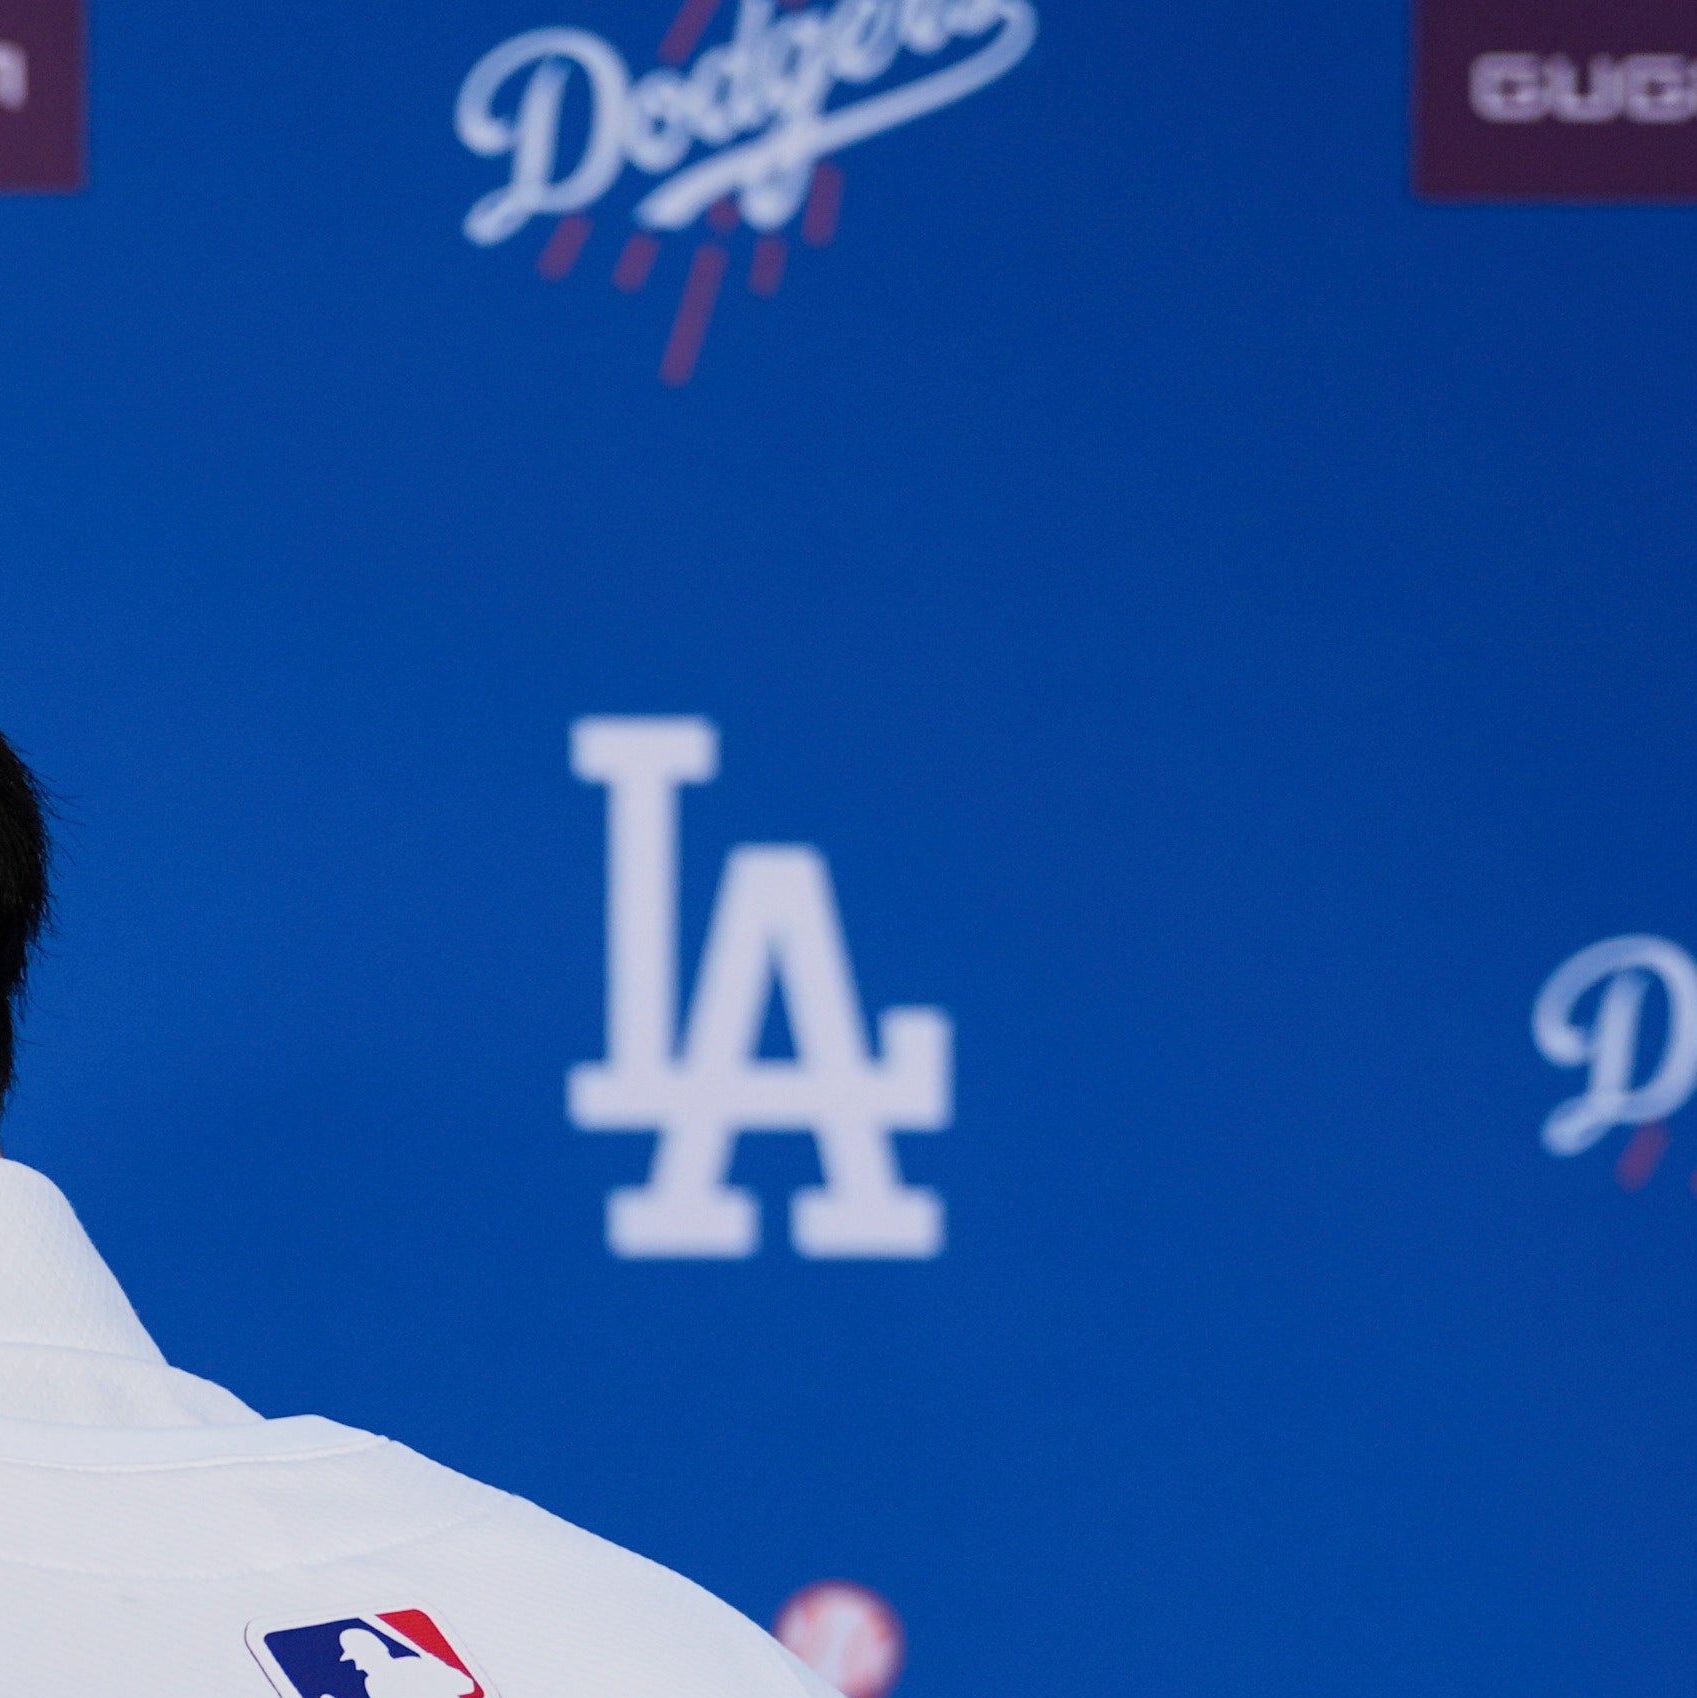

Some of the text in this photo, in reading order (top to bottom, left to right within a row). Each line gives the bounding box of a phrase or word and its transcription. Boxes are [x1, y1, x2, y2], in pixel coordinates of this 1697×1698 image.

[455, 0, 1036, 247] Dodge
[1468, 51, 1697, 123] GUG
[566, 715, 955, 1260] LA
